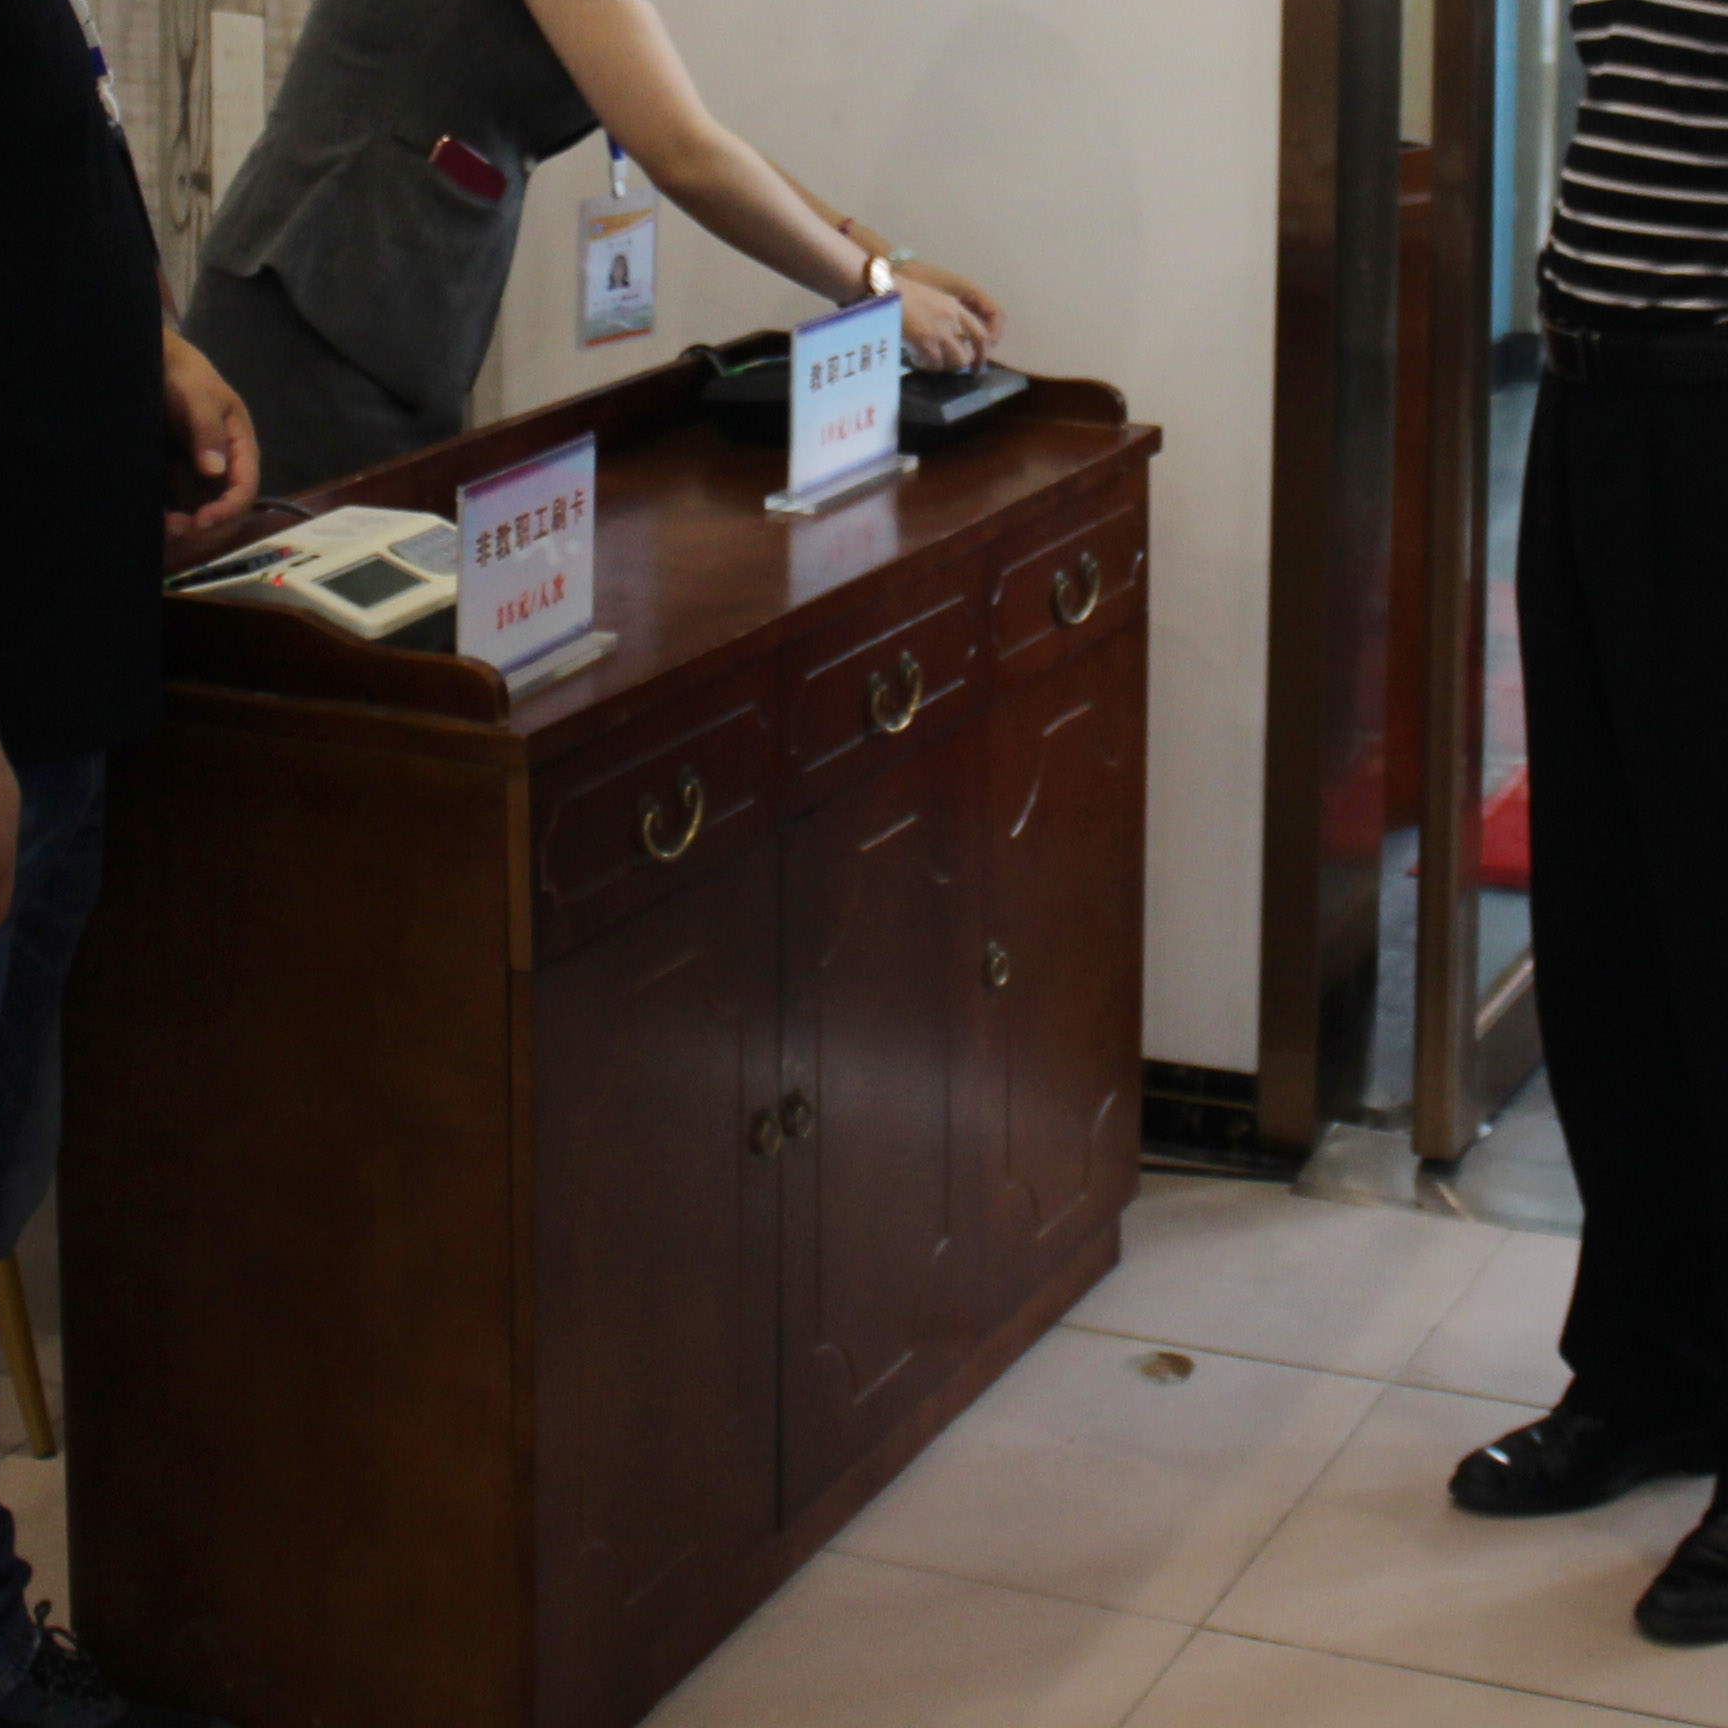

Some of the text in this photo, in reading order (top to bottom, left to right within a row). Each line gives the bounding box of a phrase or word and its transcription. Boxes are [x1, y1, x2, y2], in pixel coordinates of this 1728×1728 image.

[810, 337, 888, 393] 教职工刷卡
[475, 488, 586, 568] 非教职工刷卡
